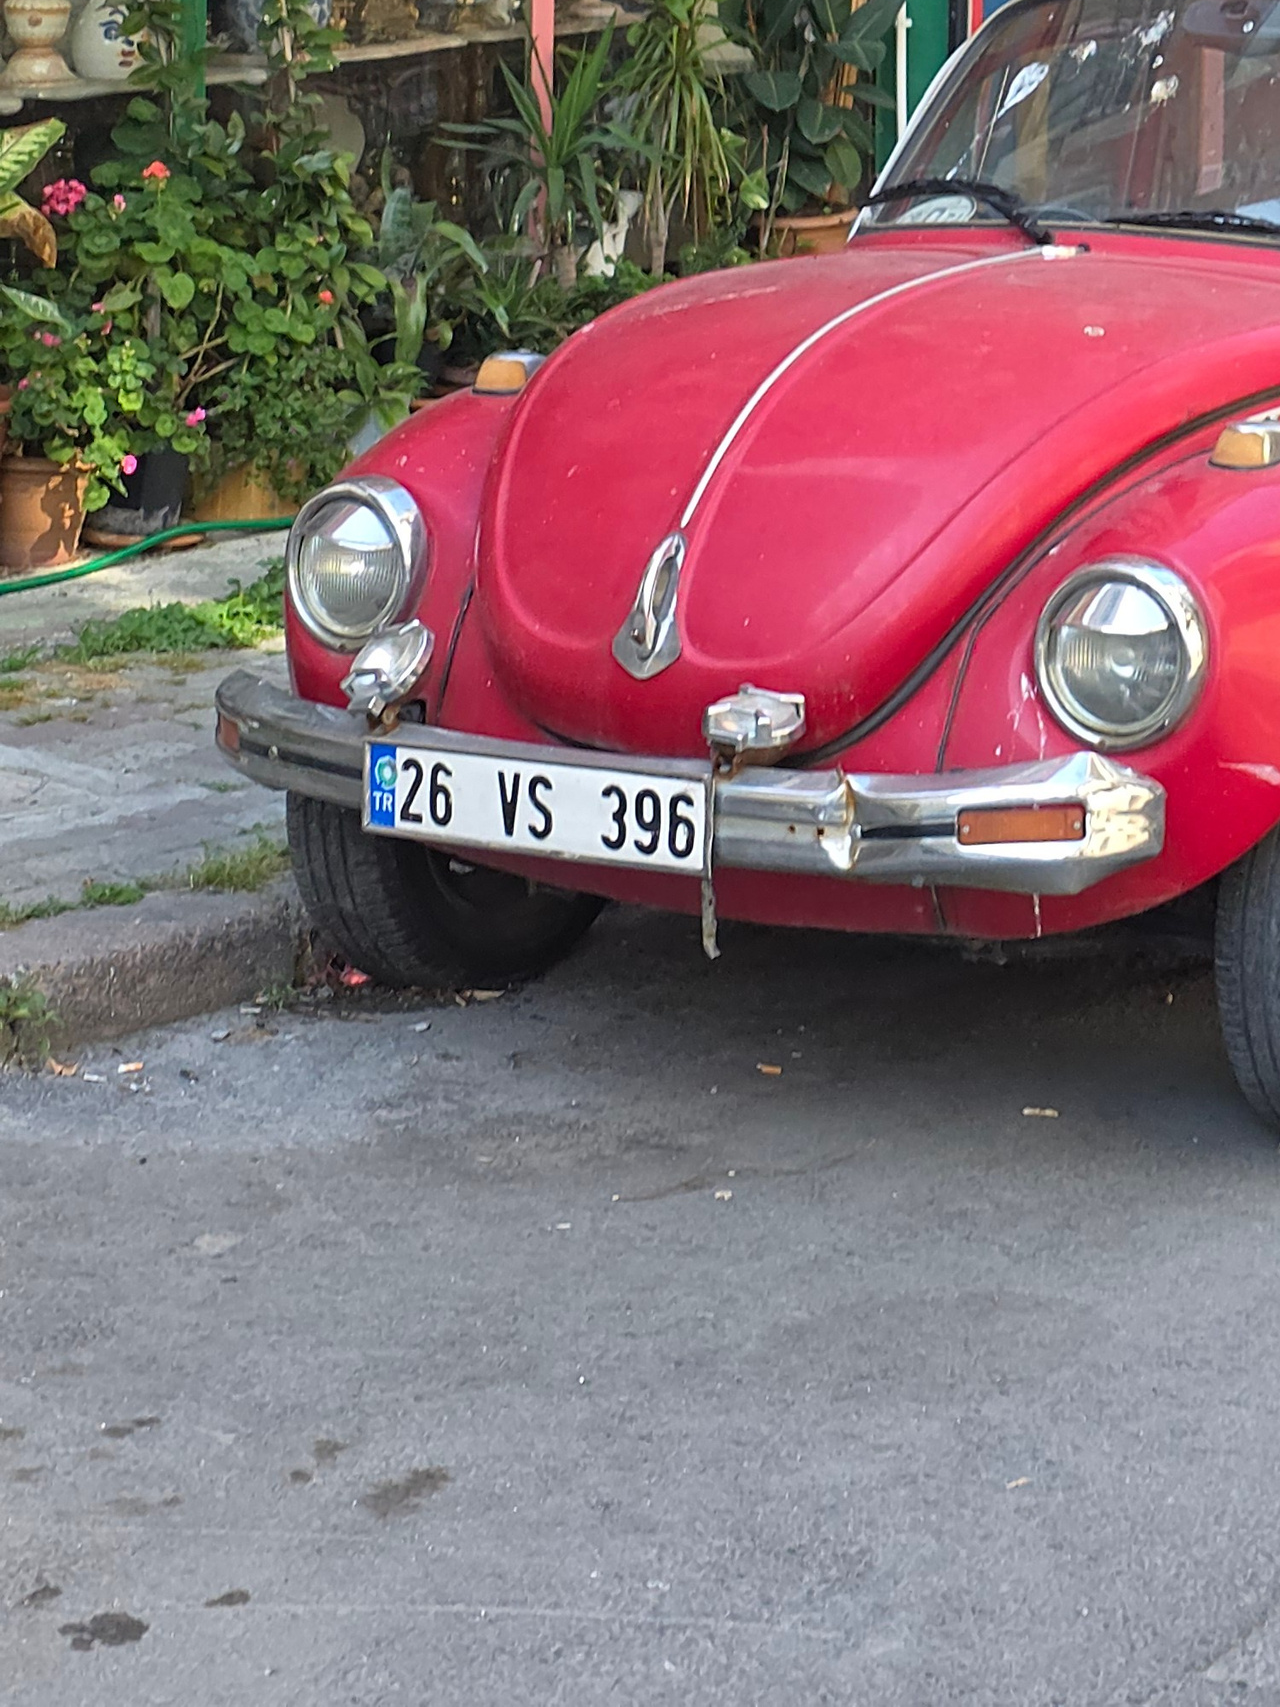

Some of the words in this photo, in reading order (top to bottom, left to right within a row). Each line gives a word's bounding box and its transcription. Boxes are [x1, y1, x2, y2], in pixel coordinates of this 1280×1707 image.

[373, 790, 393, 814] TR
[399, 757, 453, 826] 26
[497, 770, 553, 840] VS
[601, 784, 696, 859] 396
